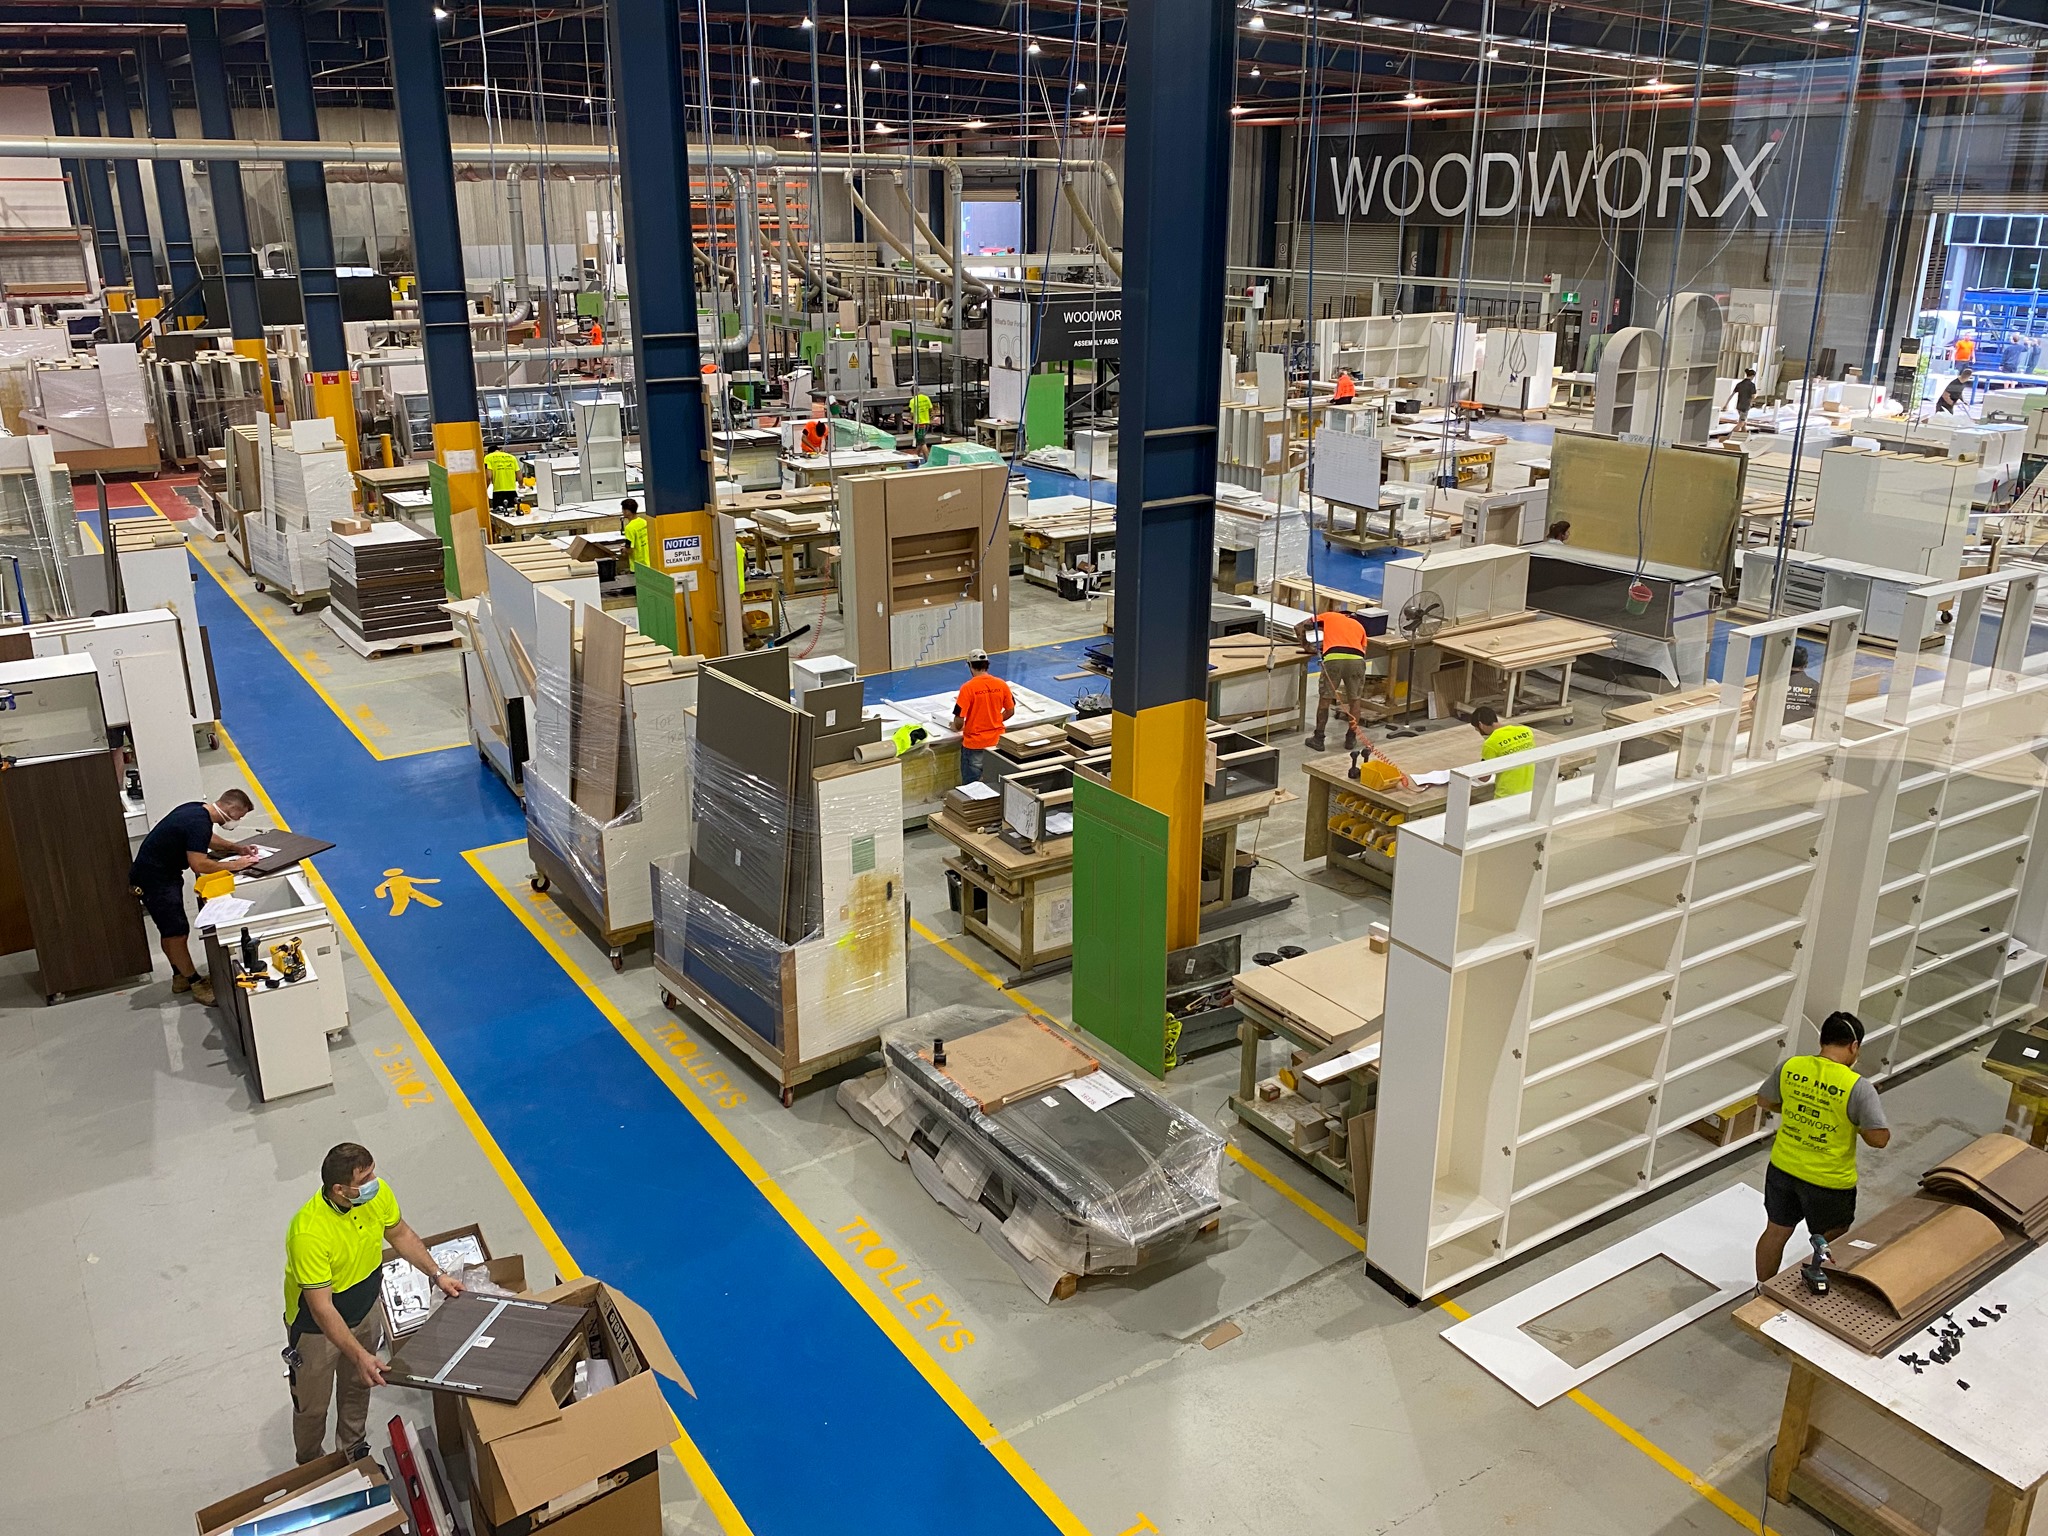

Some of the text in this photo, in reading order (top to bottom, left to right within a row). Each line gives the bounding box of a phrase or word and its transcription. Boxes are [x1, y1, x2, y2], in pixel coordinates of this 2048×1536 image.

[1330, 142, 1776, 218] WOODWORX
[1063, 309, 1121, 324] WOODWOR
[1103, 338, 1119, 346] AREA
[665, 538, 697, 549] NOTICE
[373, 1043, 435, 1109] ZONE C
[652, 1019, 748, 1110] TROLLEYS
[1786, 1071, 1846, 1097] TOP KNOT
[836, 1214, 976, 1354] TROLLEYS
[609, 1312, 628, 1350] Miele
